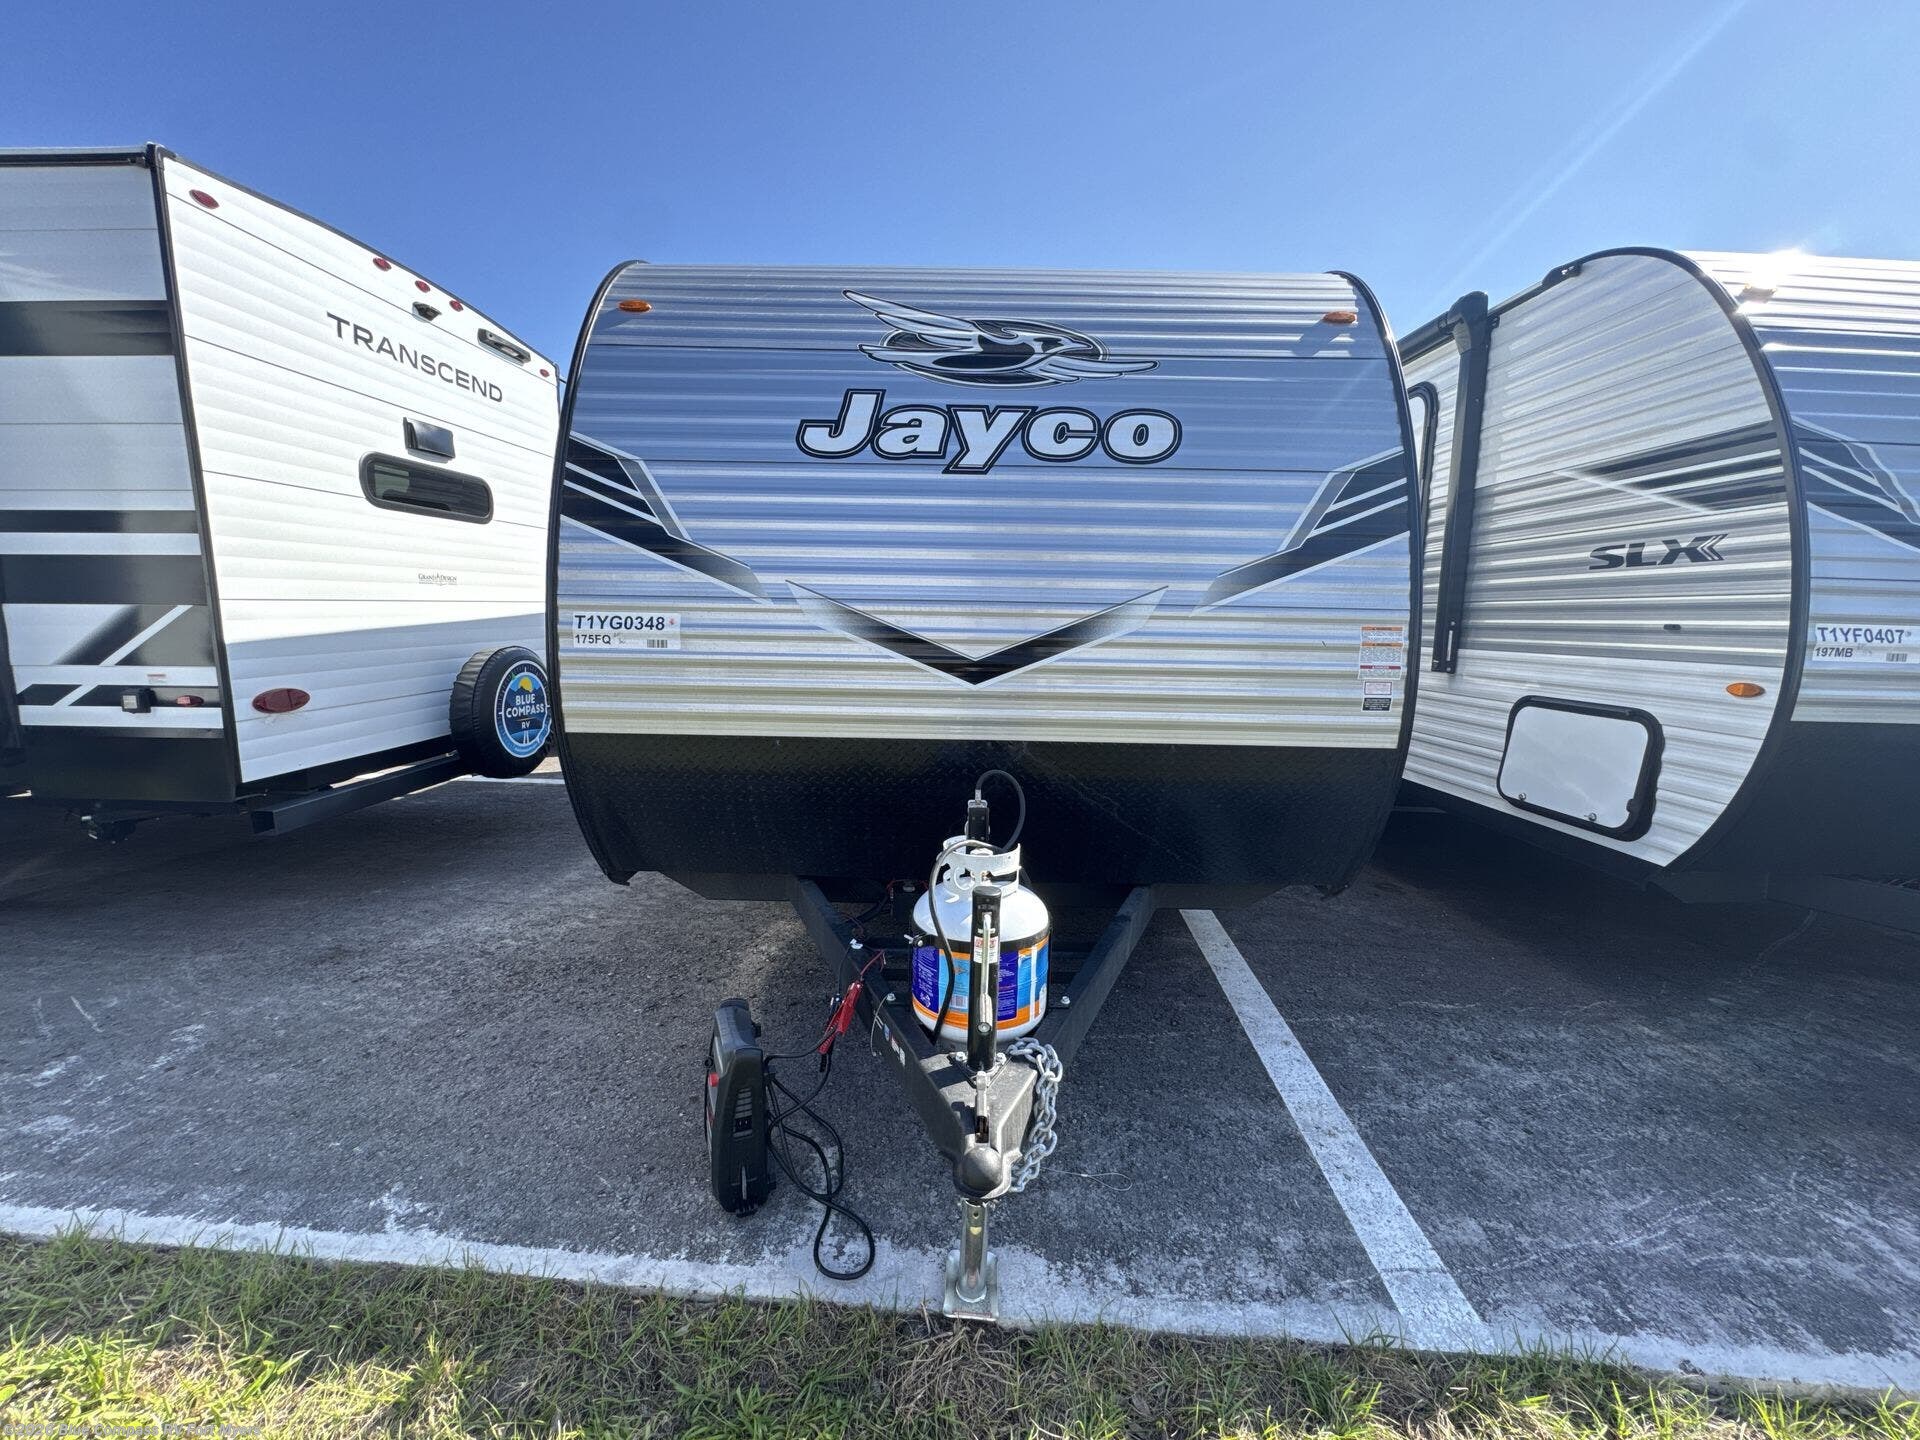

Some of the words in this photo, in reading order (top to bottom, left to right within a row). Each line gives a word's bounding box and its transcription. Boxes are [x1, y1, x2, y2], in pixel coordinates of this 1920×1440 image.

[326, 312, 503, 403] TRANSCEND
[796, 388, 1182, 474] Jayco
[1589, 534, 1729, 569] SLX
[575, 615, 665, 630] T1YG0348
[575, 634, 611, 645] 175FQ
[1817, 627, 1905, 644] T1YF0407
[1815, 647, 1853, 657] 197MB
[515, 694, 536, 705] BLUE
[506, 704, 544, 718] COMPASS
[521, 721, 530, 729] RV
